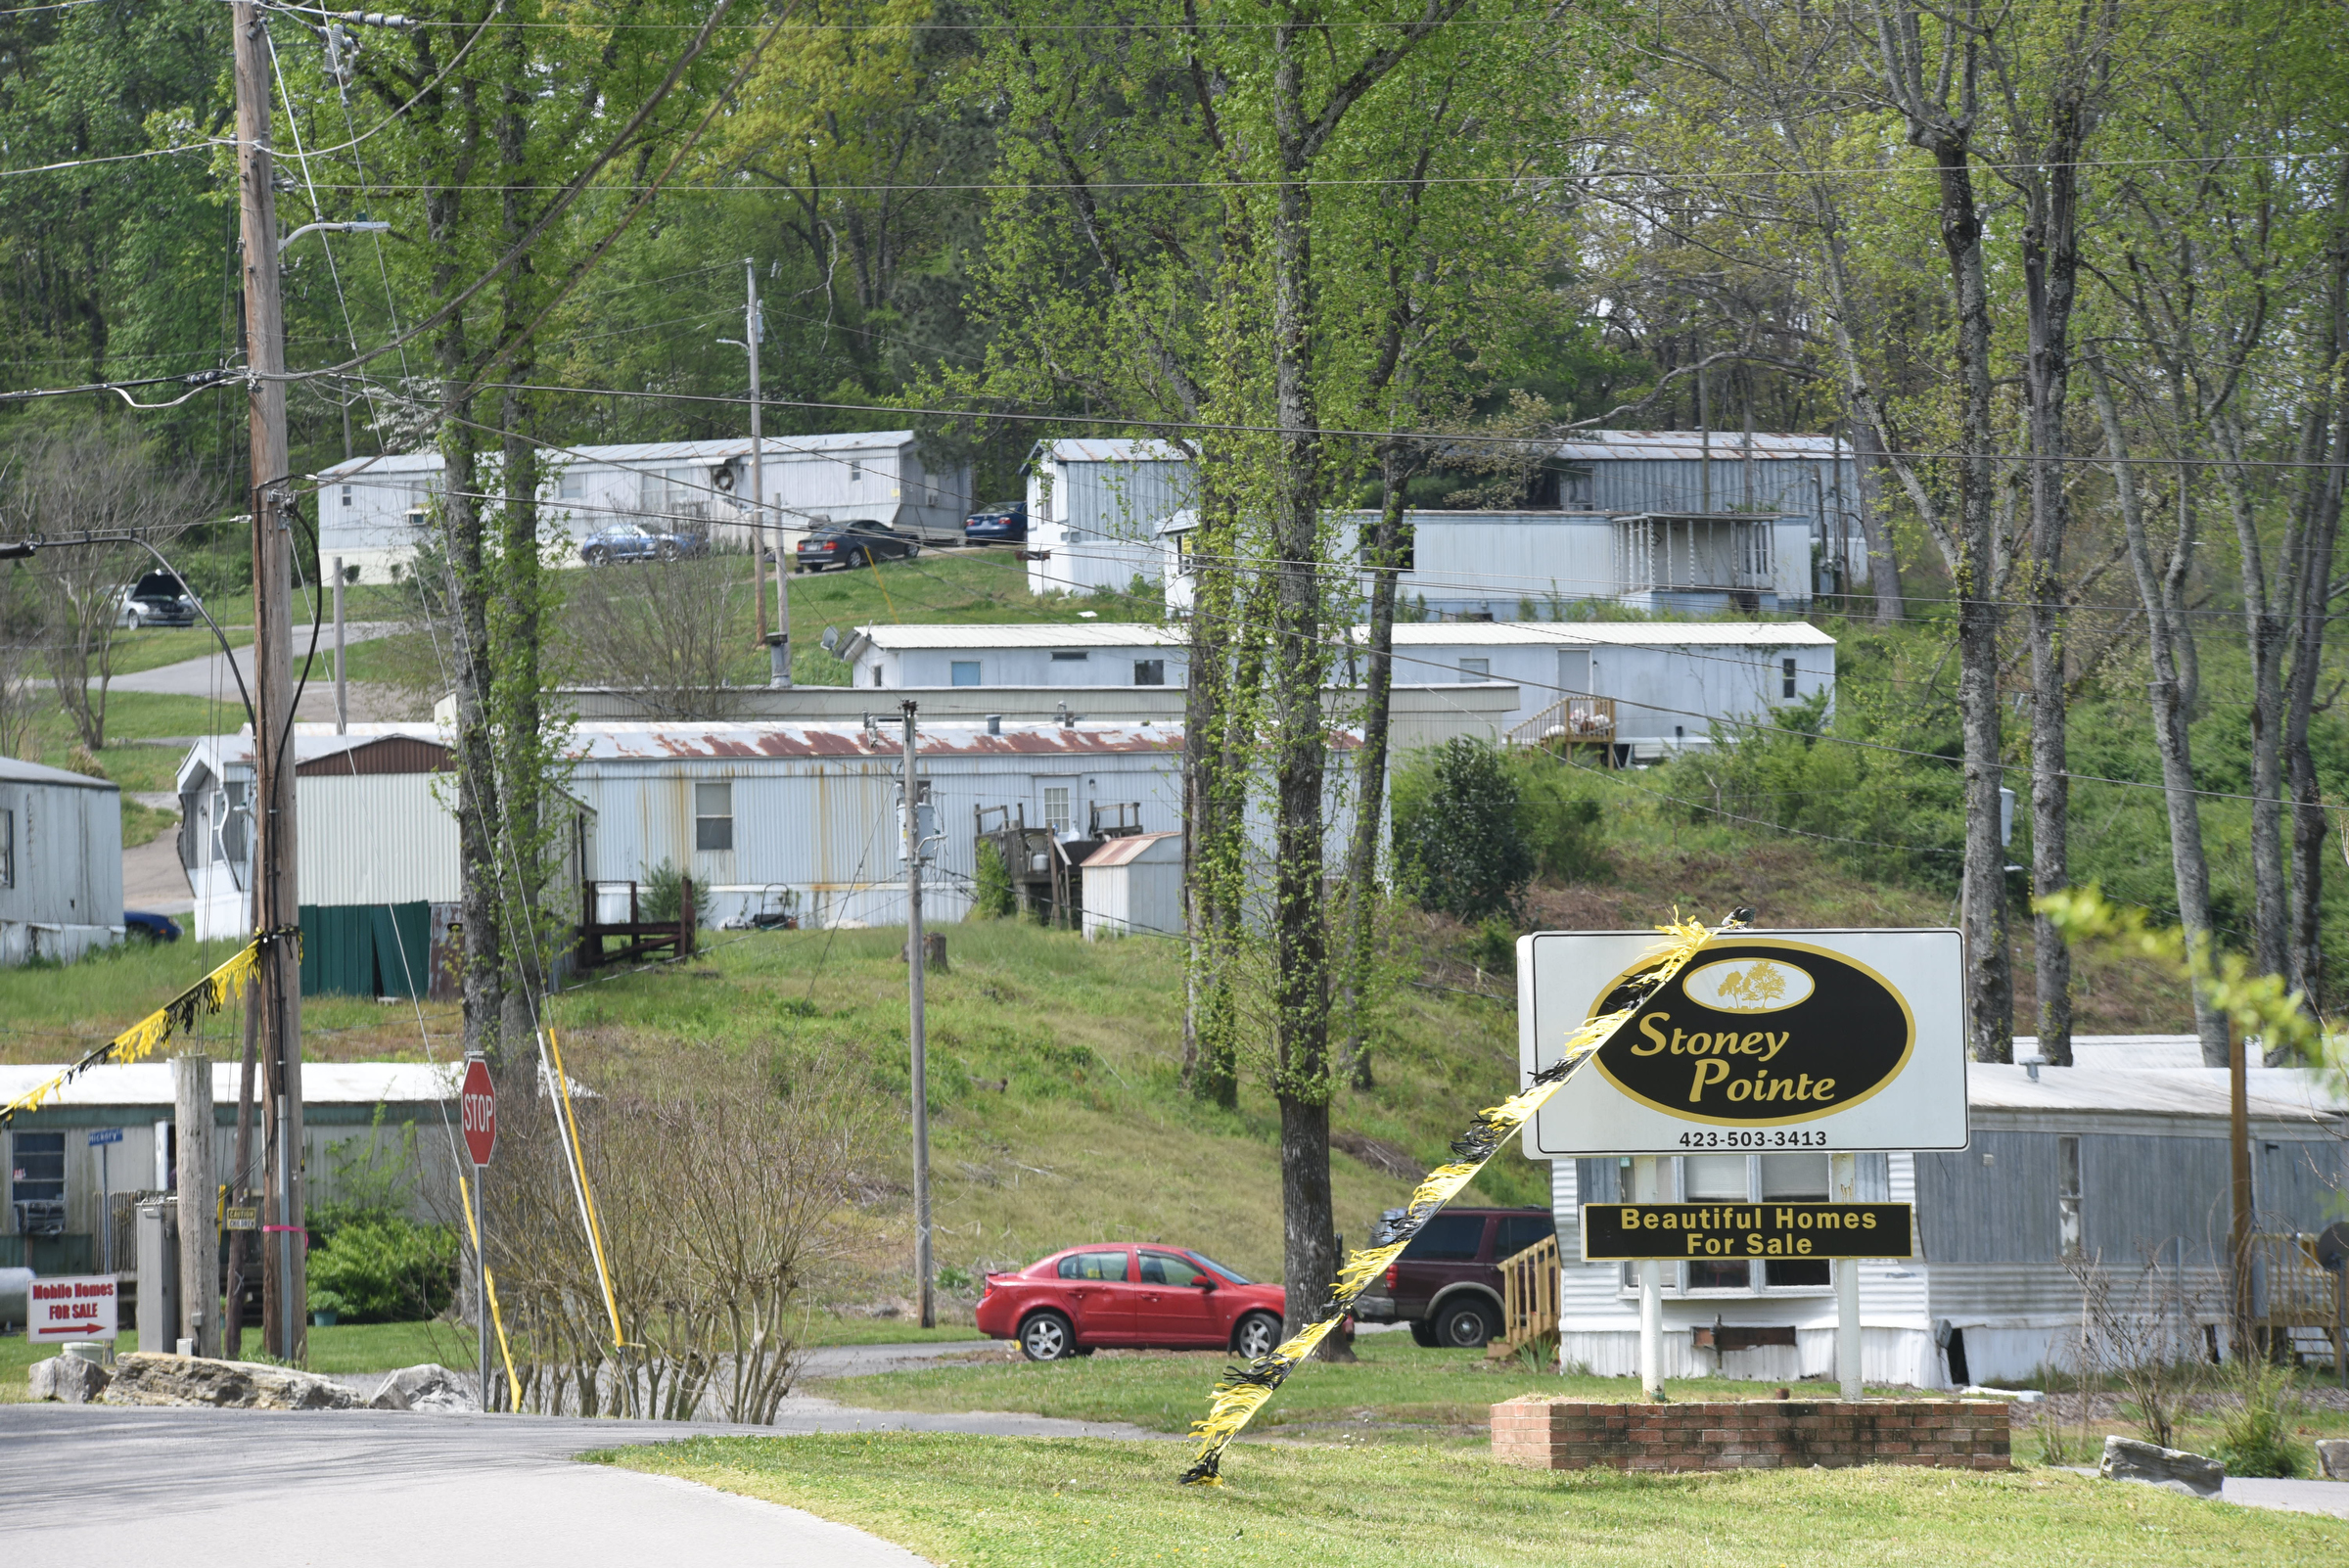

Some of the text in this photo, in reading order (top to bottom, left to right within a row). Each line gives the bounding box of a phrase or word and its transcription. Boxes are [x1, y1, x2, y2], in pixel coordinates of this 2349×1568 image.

[1631, 1011, 1790, 1062] Stoney
[1688, 1058, 1836, 1103] Pointe
[464, 1093, 493, 1133] STOP
[1679, 1130, 1827, 1147] 423-503-3413
[1621, 1207, 1877, 1229] Beautiful Homes
[1686, 1232, 1813, 1255] For Sale
[32, 1282, 114, 1300] Mobile Homes
[49, 1302, 98, 1320] FOR SALE
